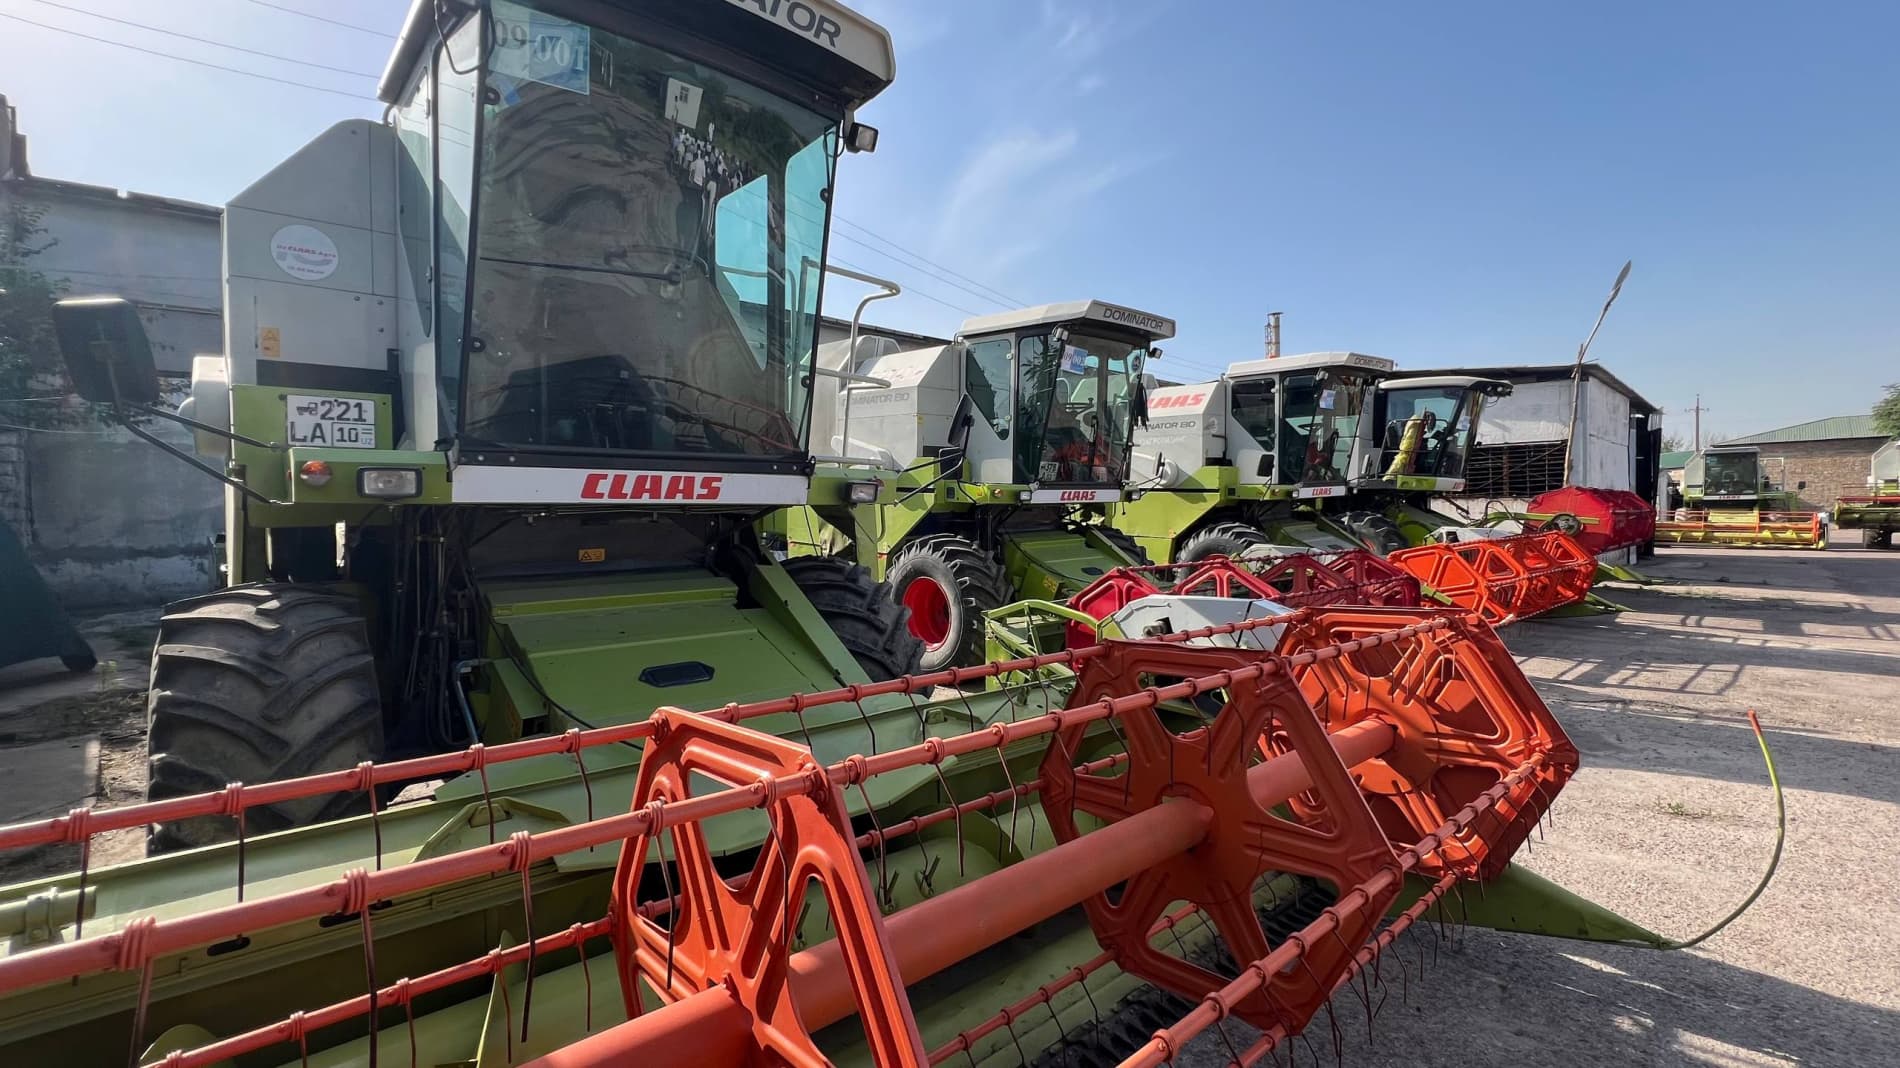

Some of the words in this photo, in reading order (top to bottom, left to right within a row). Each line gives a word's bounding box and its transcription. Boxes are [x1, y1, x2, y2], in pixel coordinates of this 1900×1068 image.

[1103, 308, 1164, 330] DOMINATOR
[320, 400, 367, 422] 221
[290, 421, 326, 443] LA
[336, 427, 359, 443] 10
[580, 473, 723, 500] CLAAS
[1060, 491, 1096, 501] CLAAS
[1311, 487, 1332, 496] CLAAS
